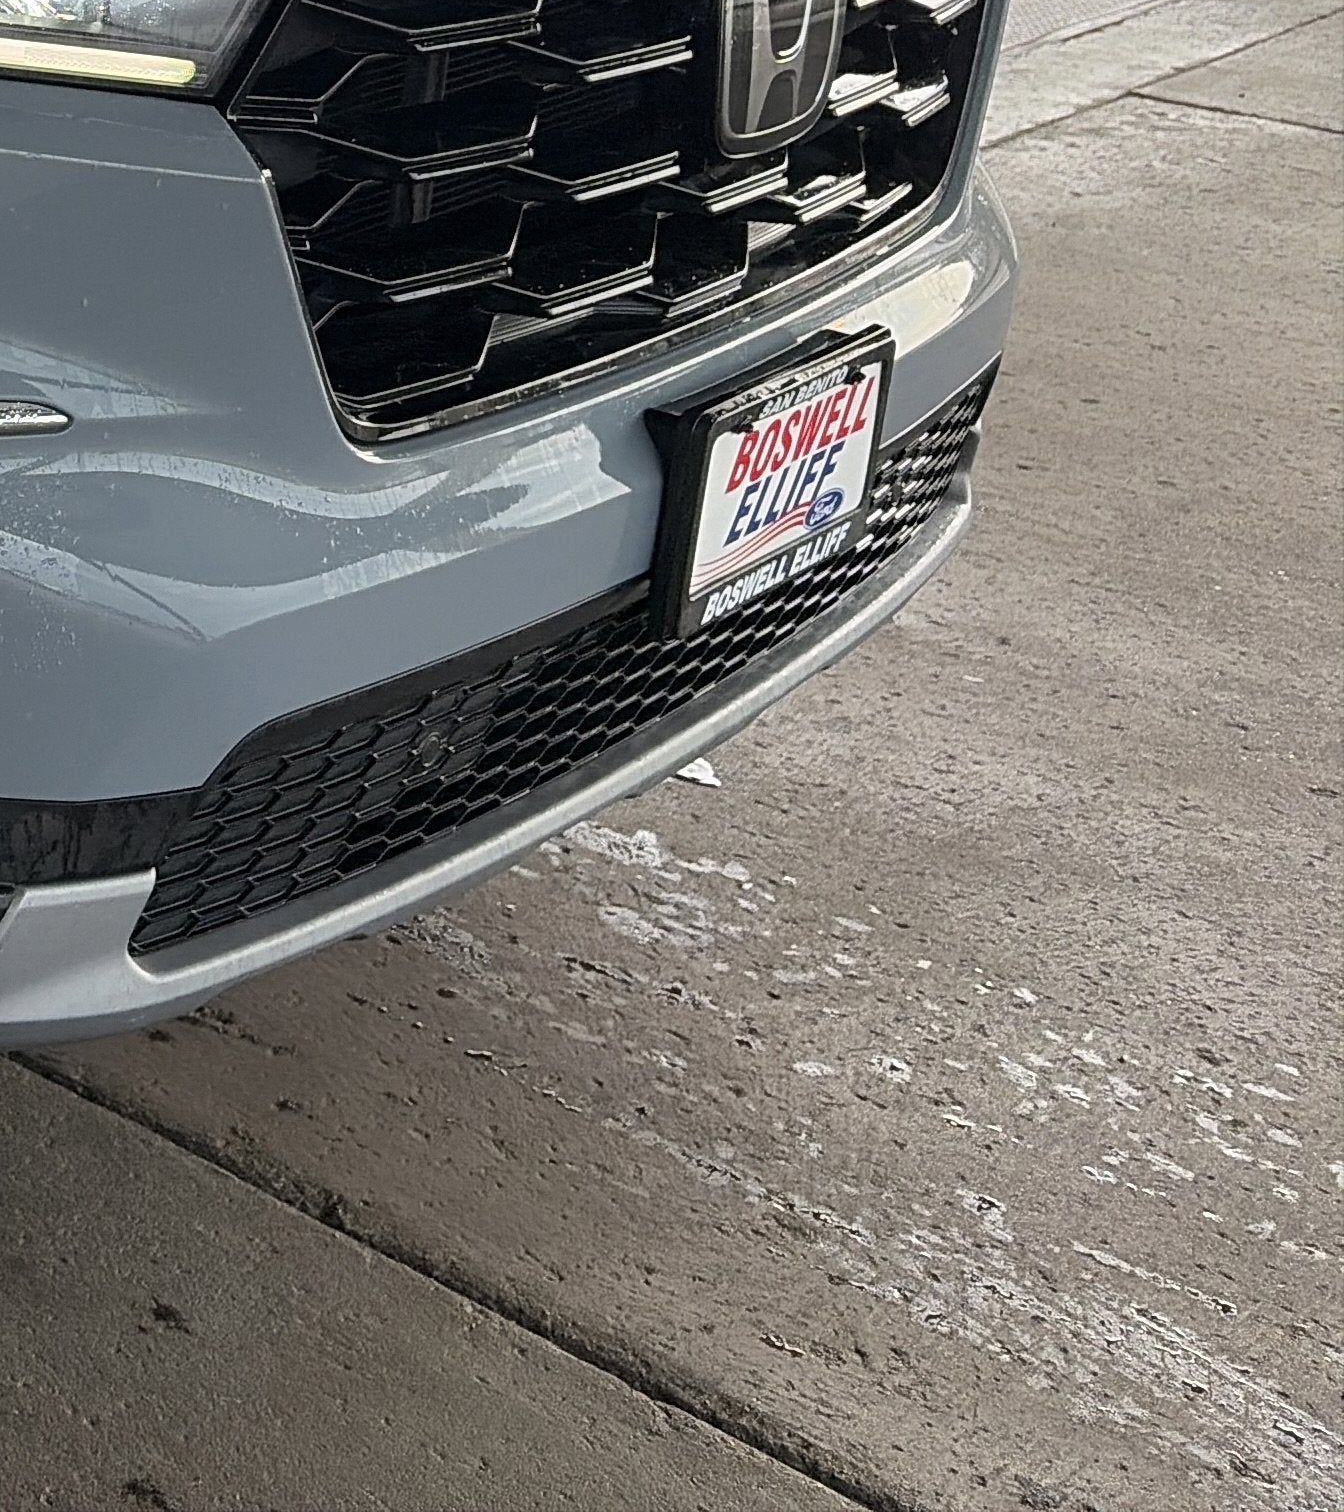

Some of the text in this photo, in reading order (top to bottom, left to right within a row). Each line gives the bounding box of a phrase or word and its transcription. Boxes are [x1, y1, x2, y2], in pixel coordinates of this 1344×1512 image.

[725, 376, 876, 494] BOSWELL
[758, 364, 849, 419] SAN BENITO
[722, 441, 846, 548] ELLIFF
[700, 522, 852, 626] BOSWELL ELLIFF
